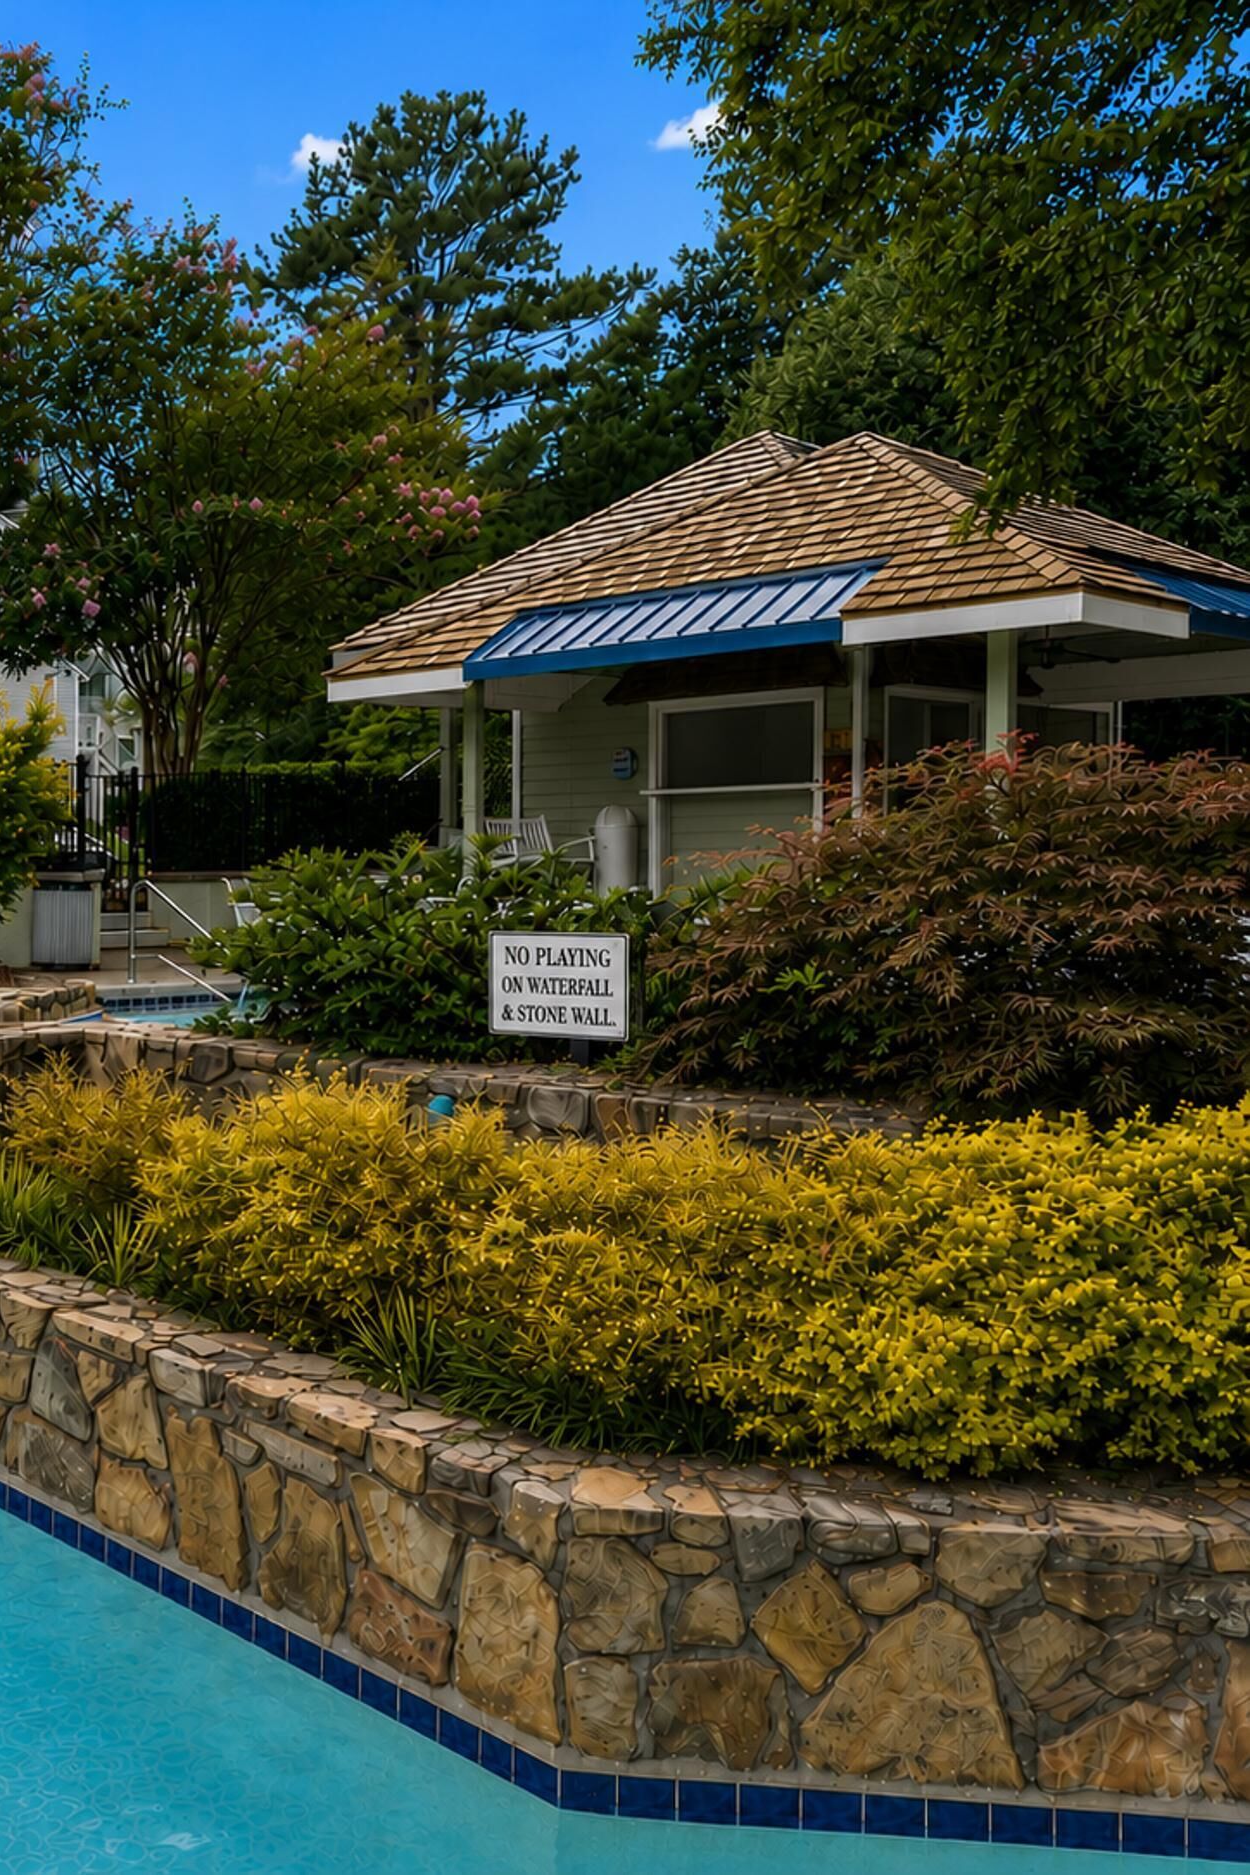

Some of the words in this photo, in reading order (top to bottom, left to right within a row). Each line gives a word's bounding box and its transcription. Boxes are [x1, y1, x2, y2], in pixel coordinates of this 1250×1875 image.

[504, 945, 530, 966] NO
[535, 947, 611, 968] PLAYING
[501, 975, 524, 994] ON
[527, 976, 614, 997] WATERFALL
[501, 1003, 515, 1022] &
[517, 1004, 568, 1025] STONE
[571, 1006, 617, 1027] WALL.
